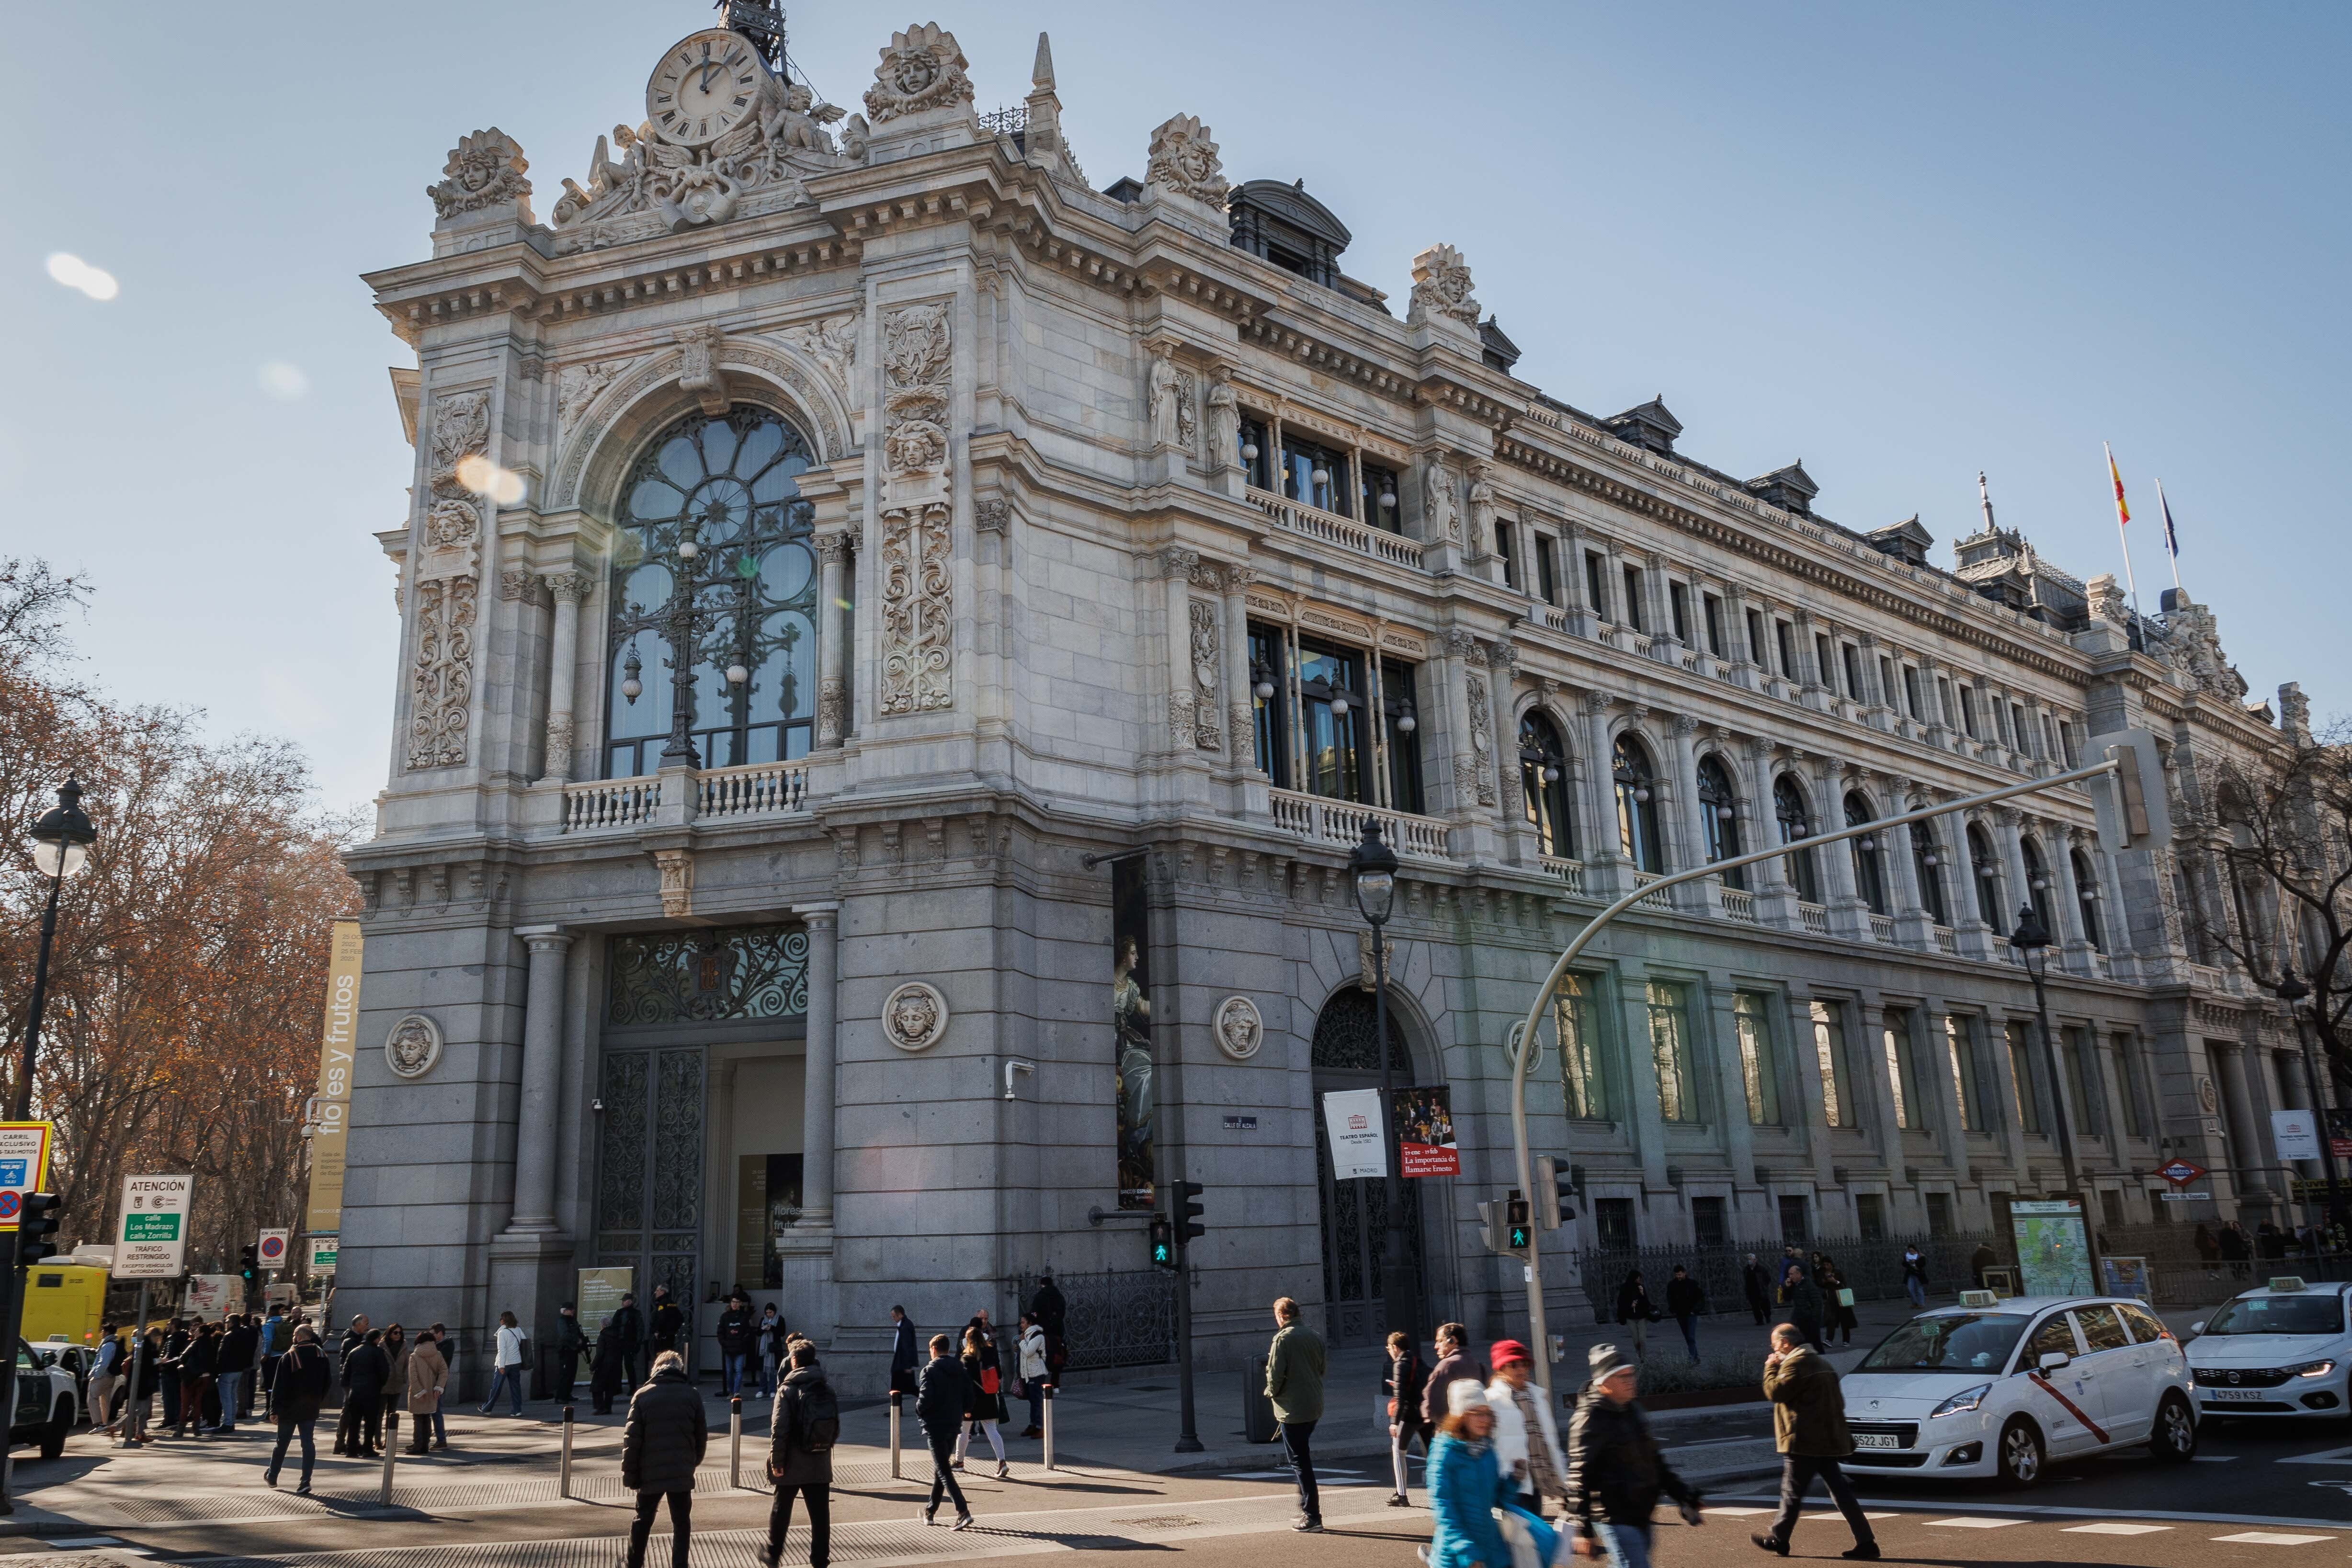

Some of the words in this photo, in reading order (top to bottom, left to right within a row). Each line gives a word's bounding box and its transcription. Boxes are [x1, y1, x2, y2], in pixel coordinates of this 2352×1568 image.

[664, 73, 678, 82] X
[721, 115, 729, 126] V
[326, 975, 354, 1044] frutos
[329, 1049, 352, 1063] y
[318, 1068, 345, 1135] floes
[1415, 1156, 1447, 1165] importancia
[130, 1179, 185, 1191] ATENCIÓN
[774, 1220, 795, 1230] fruto
[2217, 1390, 2241, 1399] 4759
[2242, 1391, 2262, 1399] KSZ
[1854, 1435, 1876, 1446] 9522
[1879, 1436, 1895, 1446] JGY
